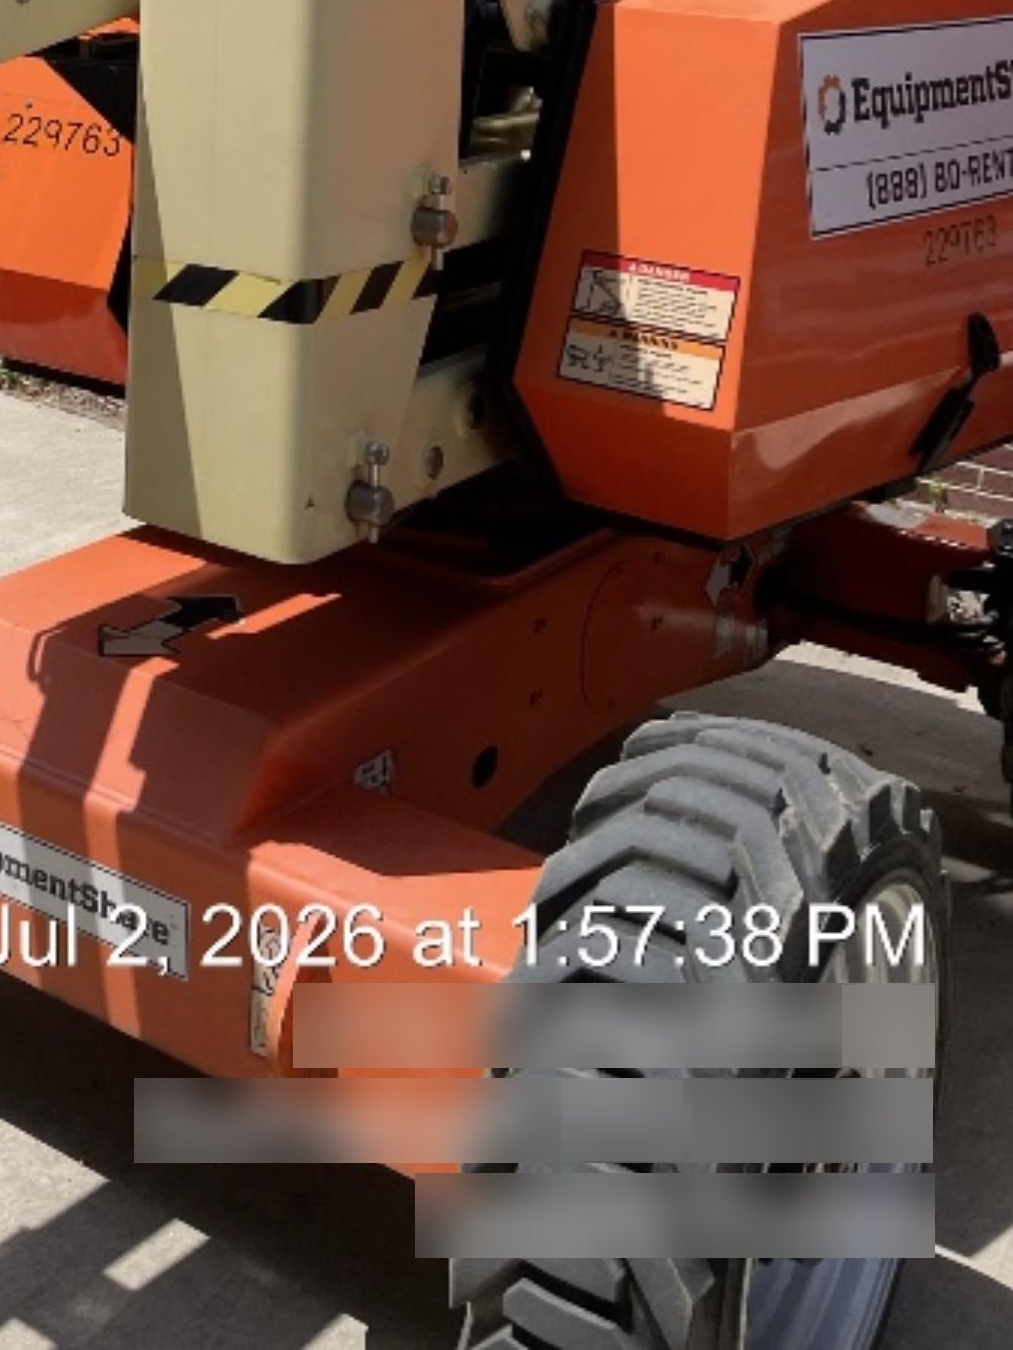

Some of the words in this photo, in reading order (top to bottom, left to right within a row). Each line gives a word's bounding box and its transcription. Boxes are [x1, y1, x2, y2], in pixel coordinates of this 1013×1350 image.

[851, 59, 1013, 130] EquipmentS
[2, 113, 121, 157] 229763
[866, 161, 928, 210] (888)
